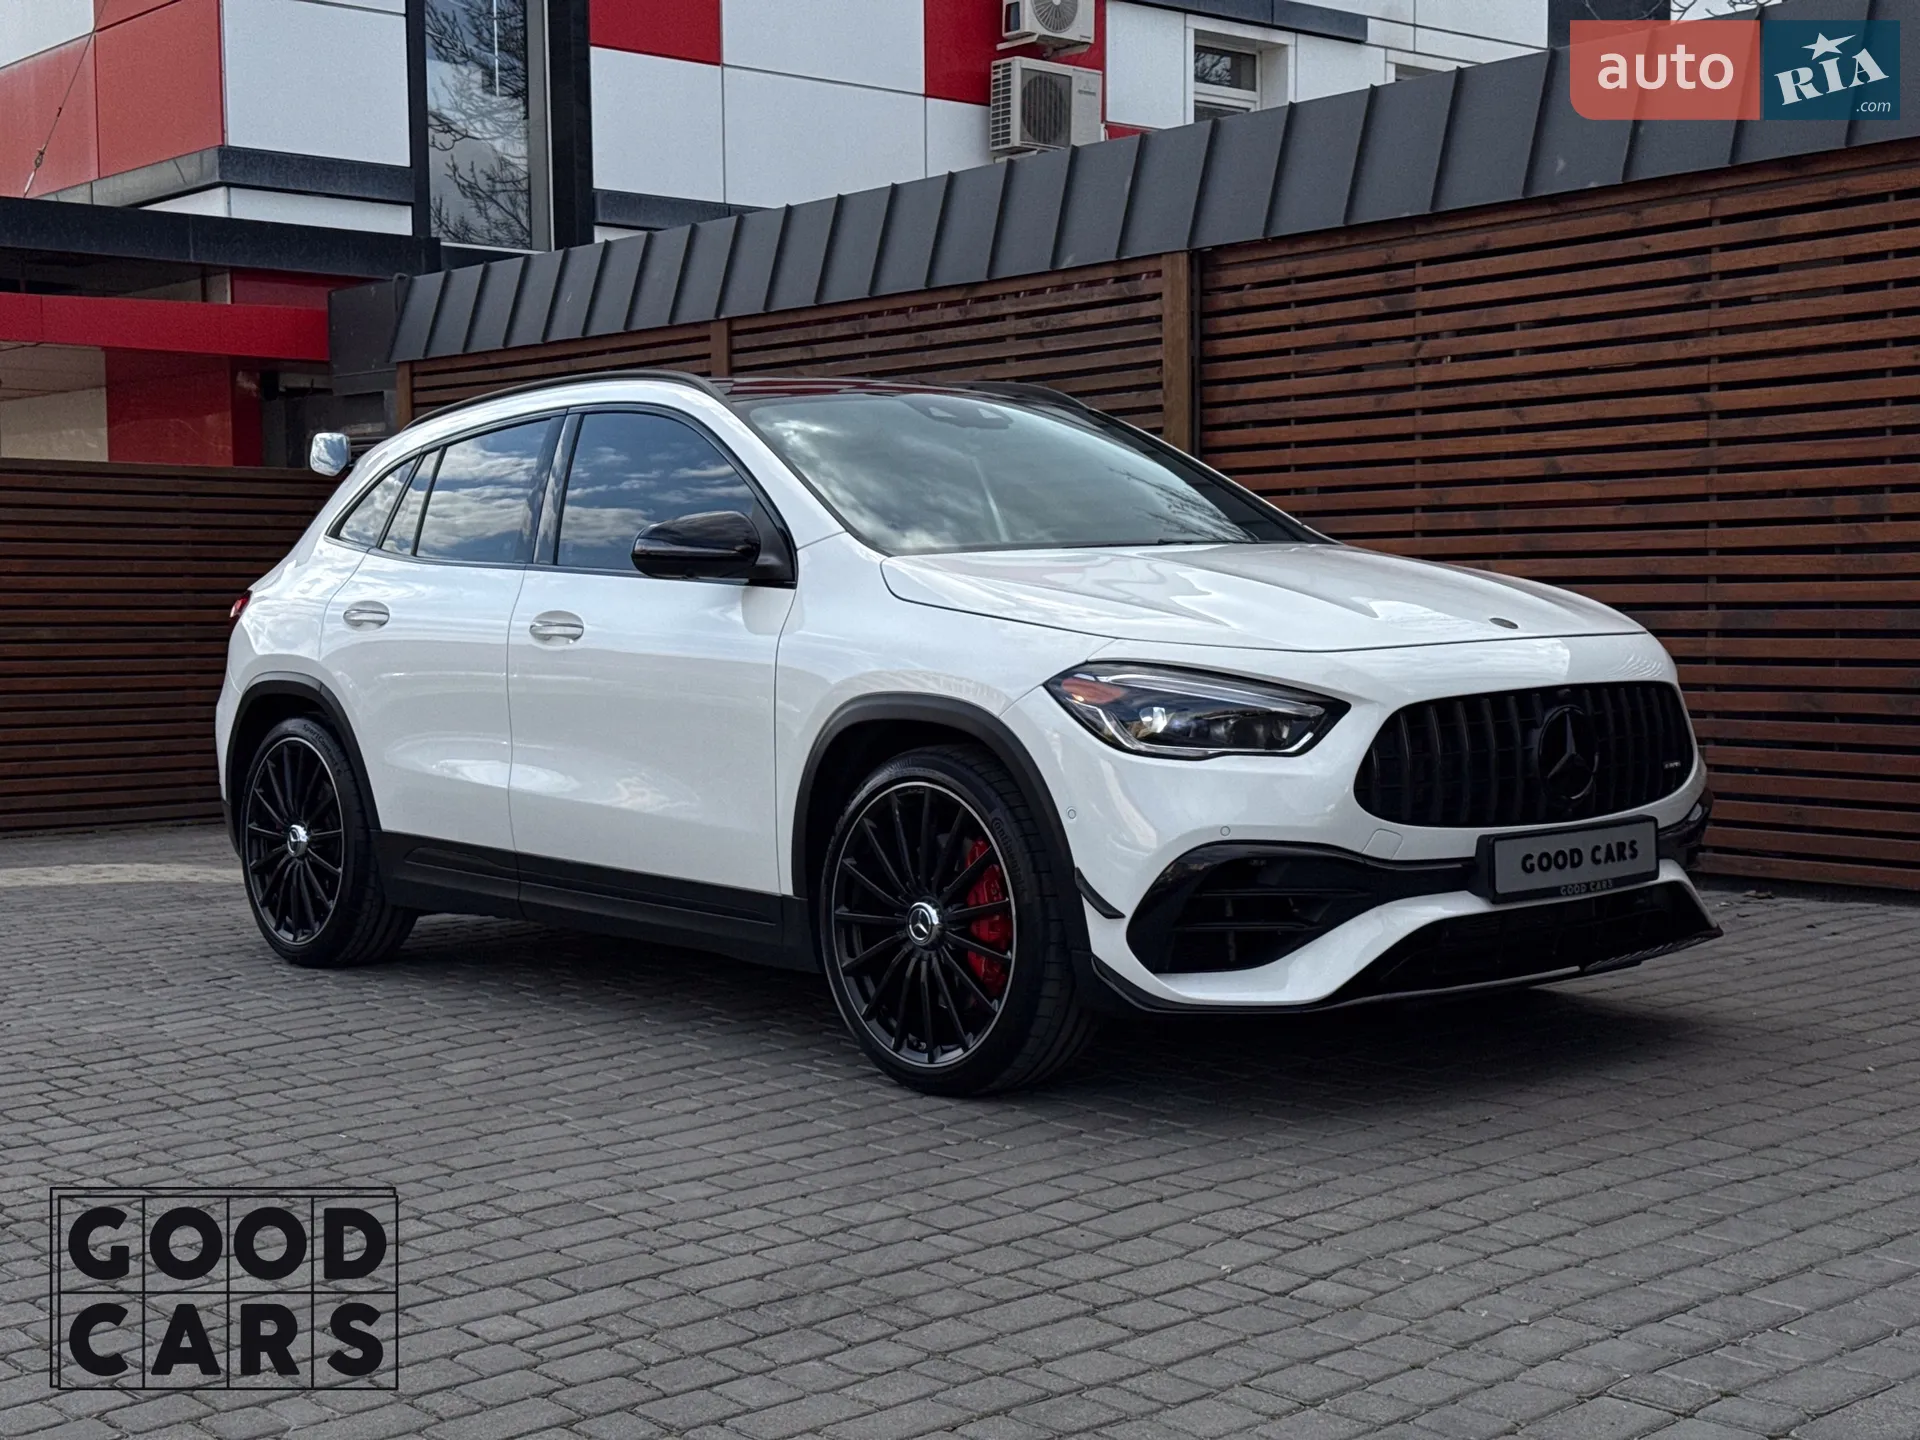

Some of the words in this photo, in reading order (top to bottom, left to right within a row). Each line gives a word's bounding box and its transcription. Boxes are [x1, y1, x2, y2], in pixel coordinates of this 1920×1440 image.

[1521, 848, 1583, 873] GOOD
[1590, 840, 1638, 865] CARS
[1560, 882, 1587, 896] GOOD
